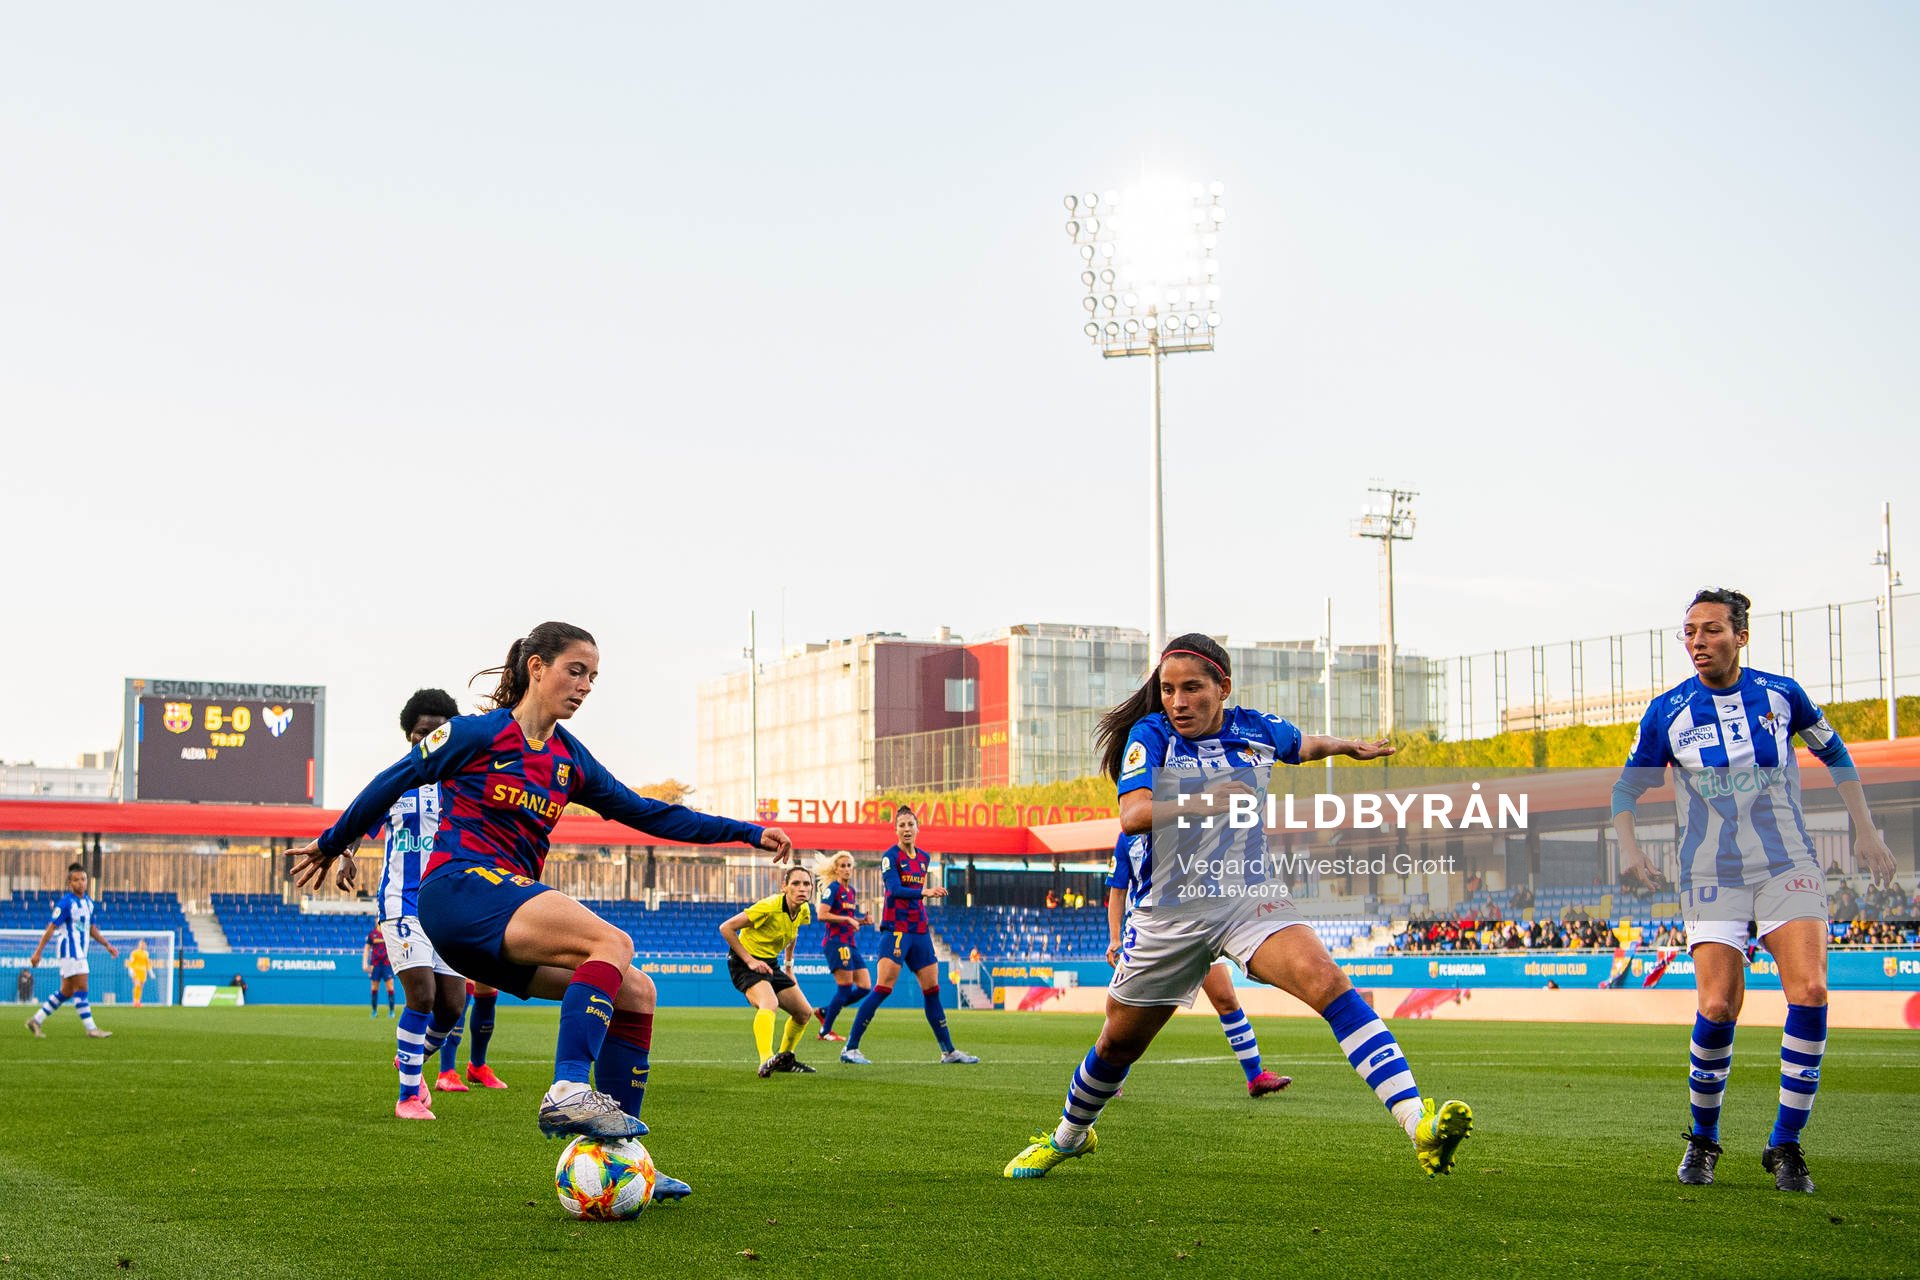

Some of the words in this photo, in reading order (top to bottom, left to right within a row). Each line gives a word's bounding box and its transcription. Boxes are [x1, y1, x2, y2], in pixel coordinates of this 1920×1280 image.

[152, 680, 201, 696] ESTADI
[207, 682, 259, 699] JOHAN
[262, 685, 320, 700] CRUYFF
[204, 706, 251, 732] 5-0
[1679, 732, 1715, 747] ESPAÑOL
[492, 784, 564, 821] STANLEY
[395, 827, 434, 853] Hue
[397, 917, 411, 938] 6
[893, 931, 903, 949] 7
[838, 946, 851, 961] 10
[272, 960, 284, 970] FC
[284, 960, 336, 971] BARCELONA
[641, 962, 660, 973] MÉS
[661, 964, 677, 974] QUE
[679, 964, 691, 974] UN
[692, 964, 713, 974] CLUB
[1354, 965, 1367, 977] QUE
[1367, 964, 1377, 975] UN
[1377, 964, 1393, 976] CLUB
[1439, 963, 1448, 976] FC
[1448, 963, 1486, 976] BARCELONA
[1524, 961, 1540, 975] MÉS
[1541, 963, 1555, 977] QUE
[1556, 963, 1567, 976] UN
[1567, 963, 1587, 976] CLUB
[1899, 960, 1912, 974] FC
